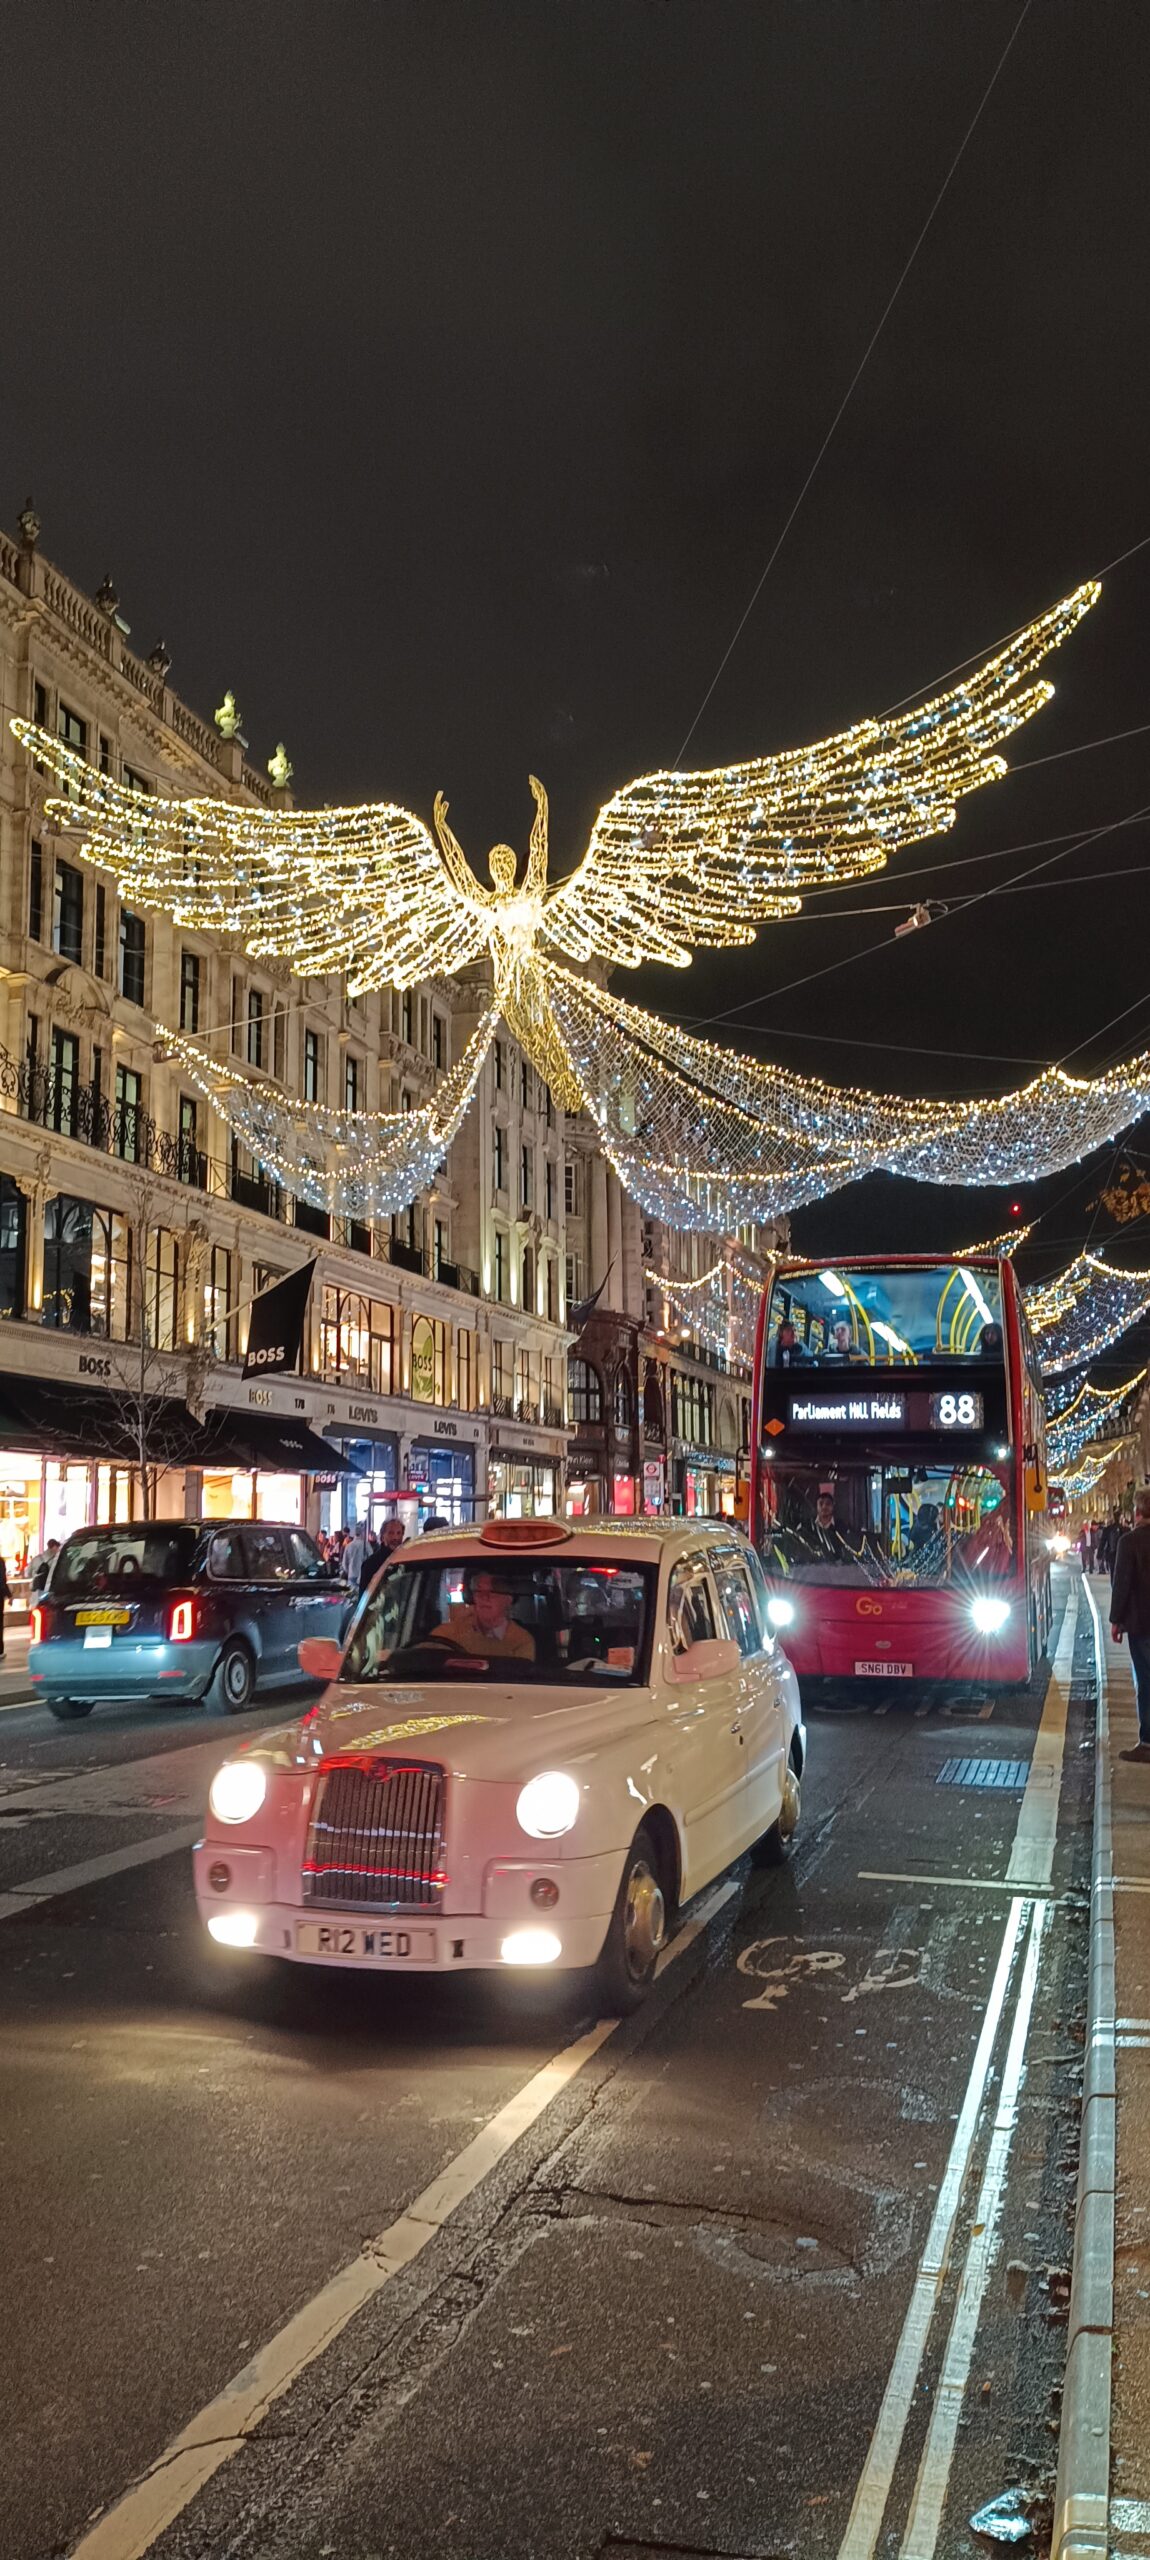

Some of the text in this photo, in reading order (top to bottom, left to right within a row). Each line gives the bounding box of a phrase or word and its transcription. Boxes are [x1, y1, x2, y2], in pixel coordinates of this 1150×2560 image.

[79, 1355, 111, 1376] BOSS
[247, 1346, 285, 1367] BOSS
[412, 1353, 432, 1372] BOSS
[249, 1388, 273, 1407] BOSS
[792, 1401, 902, 1420] Parliament Hill Fields
[939, 1394, 976, 1425] 88
[315, 1470, 337, 1484] BOSS
[855, 1596, 883, 1616] Go
[861, 1663, 907, 1676] SN61 DBV
[317, 1927, 412, 1957] R12 WED
